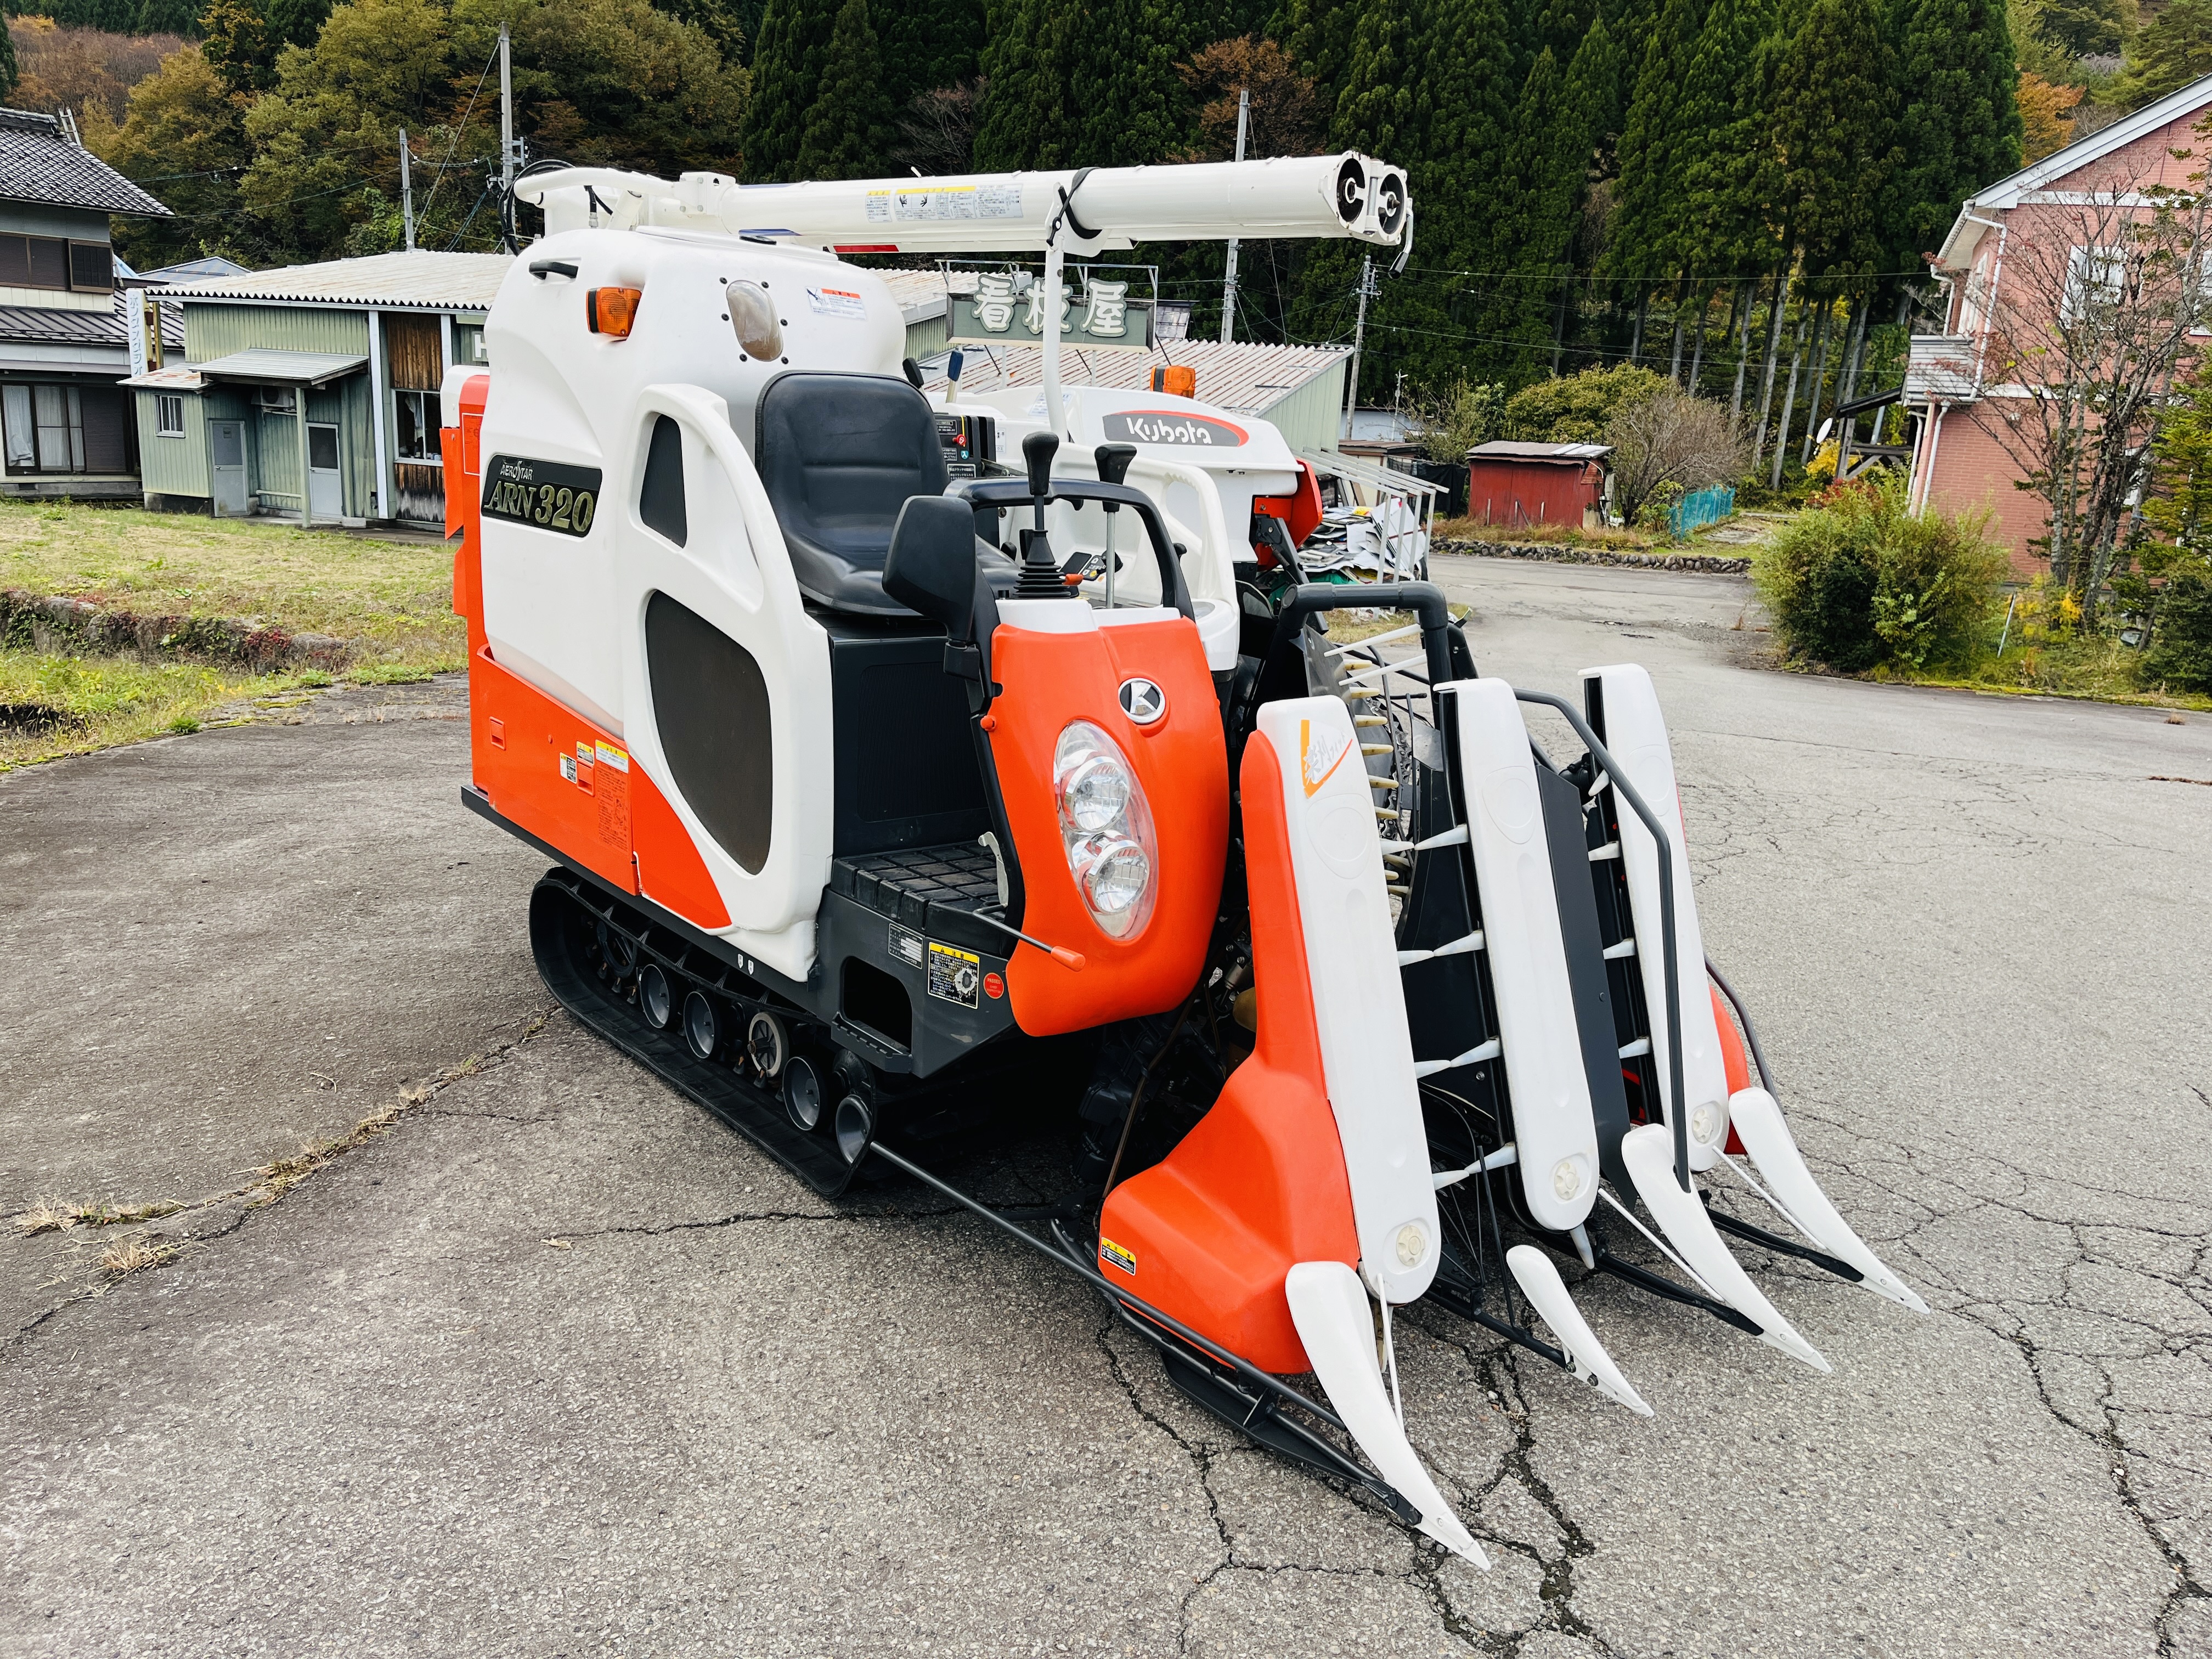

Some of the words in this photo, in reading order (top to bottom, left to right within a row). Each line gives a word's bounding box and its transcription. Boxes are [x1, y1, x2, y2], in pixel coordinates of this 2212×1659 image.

[1125, 417, 1212, 444] Kubota
[484, 481, 537, 518] ARN
[535, 484, 594, 532] 320
